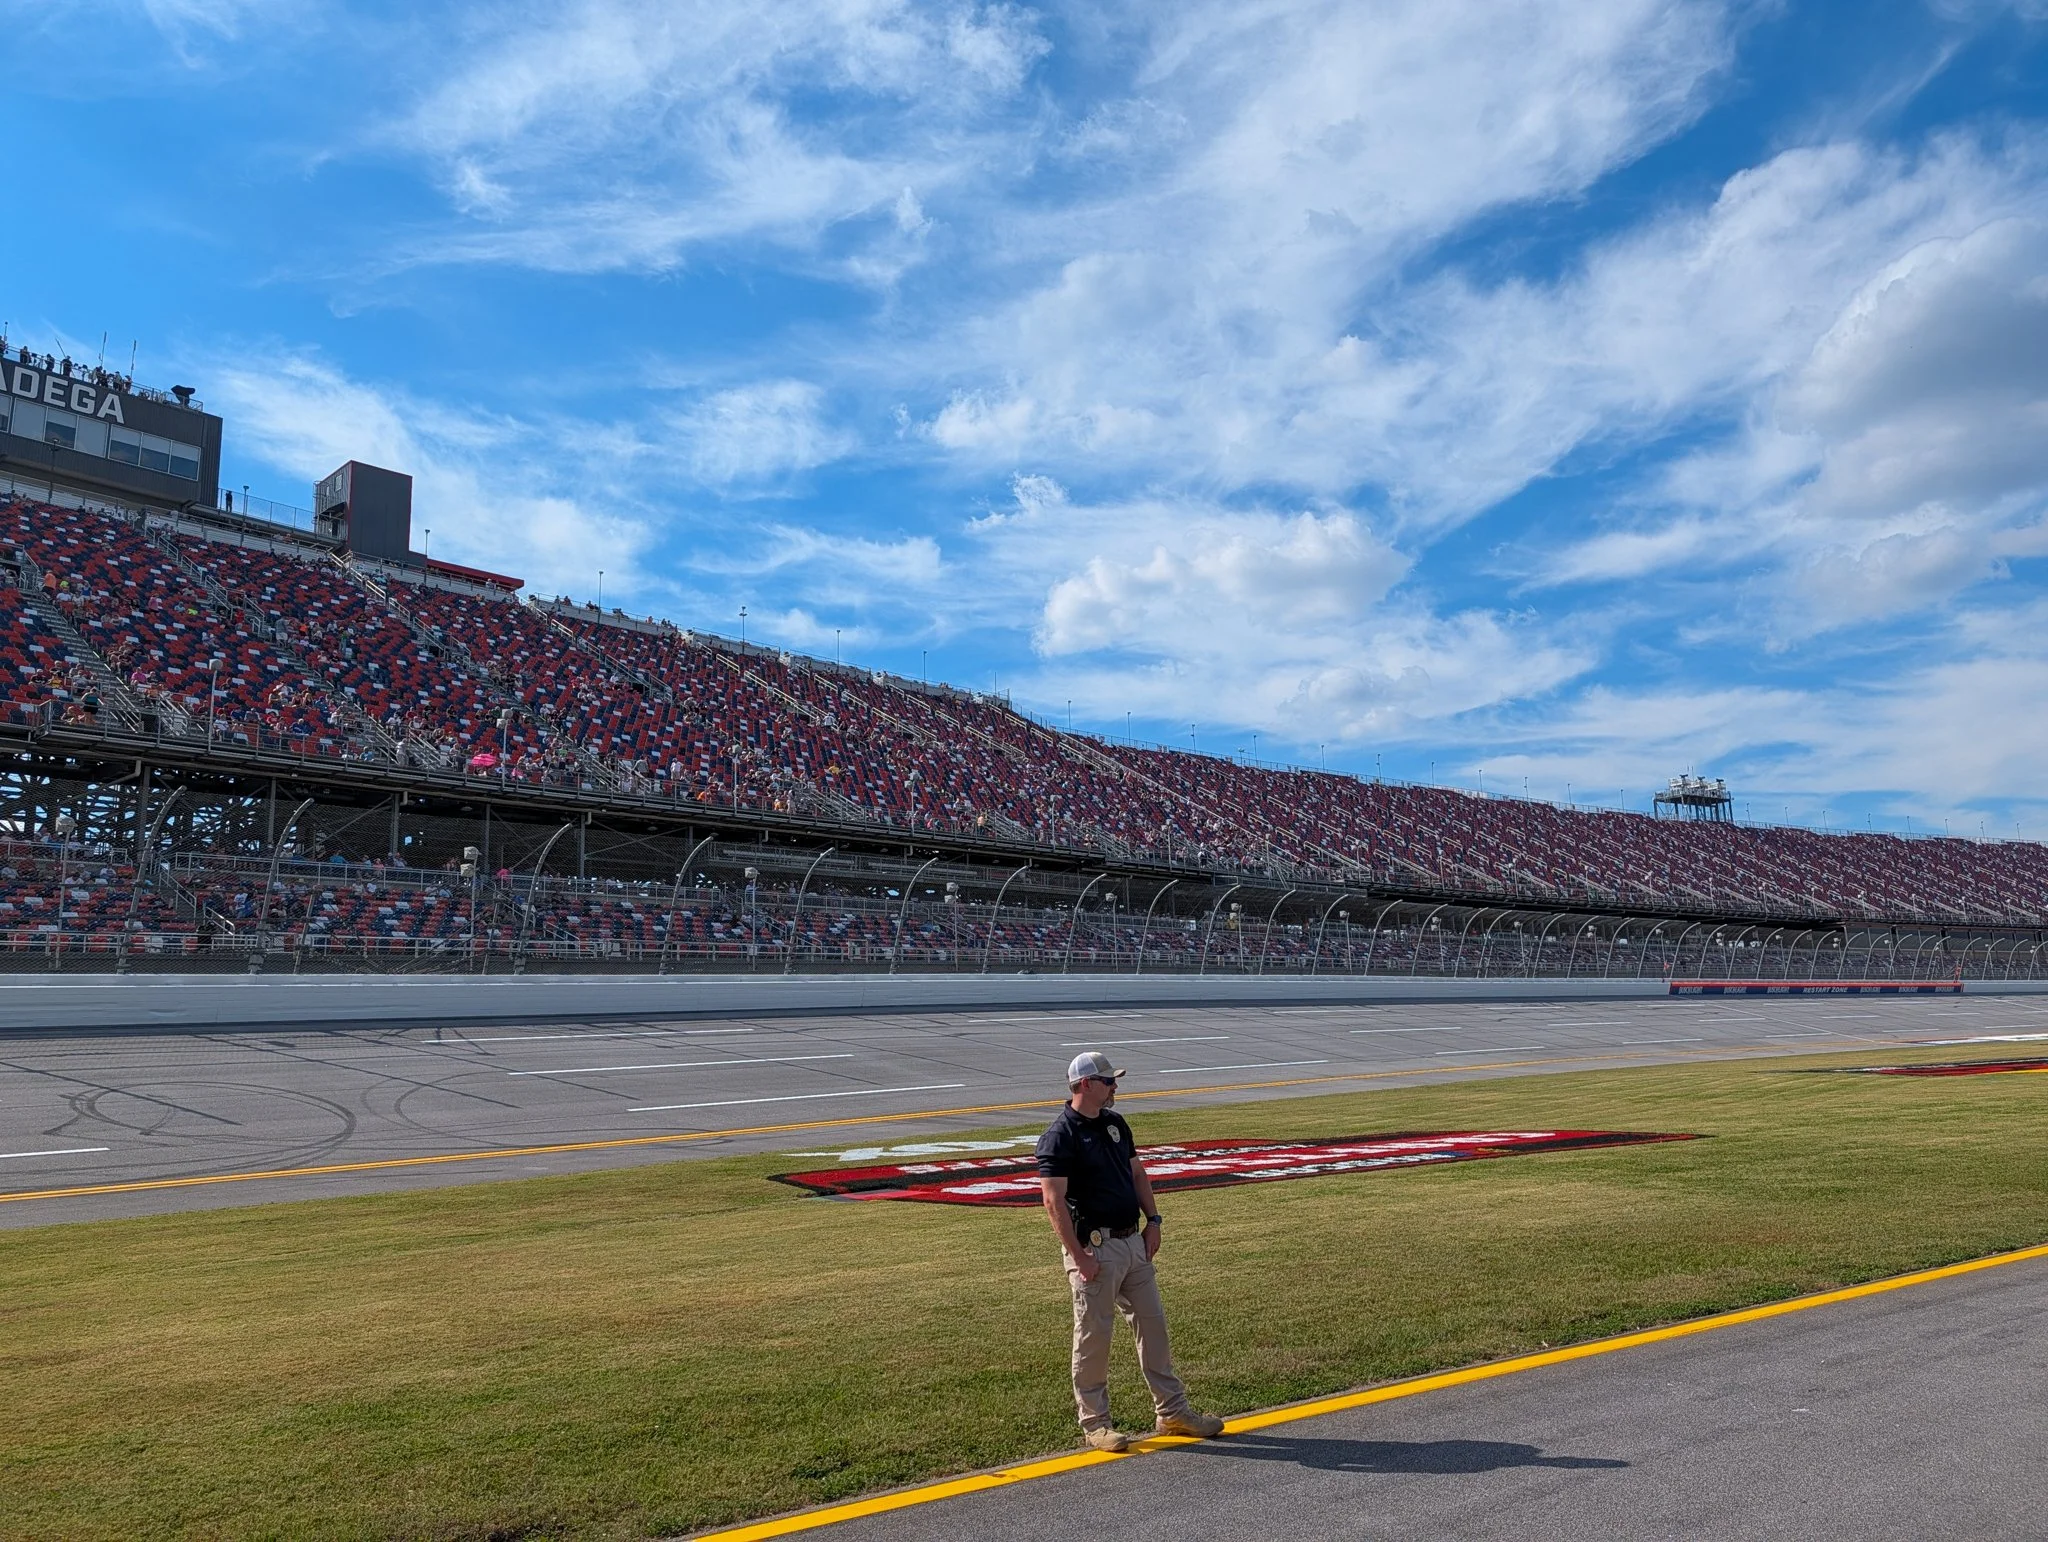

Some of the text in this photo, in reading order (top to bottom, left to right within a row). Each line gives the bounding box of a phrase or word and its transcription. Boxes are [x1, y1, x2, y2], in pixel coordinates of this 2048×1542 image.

[0, 360, 125, 424] DEGA
[898, 1145, 1187, 1174] PLOFFS
[941, 1133, 1556, 1195] CRAFTSMN
[1231, 1152, 1456, 1178] NASCAR
